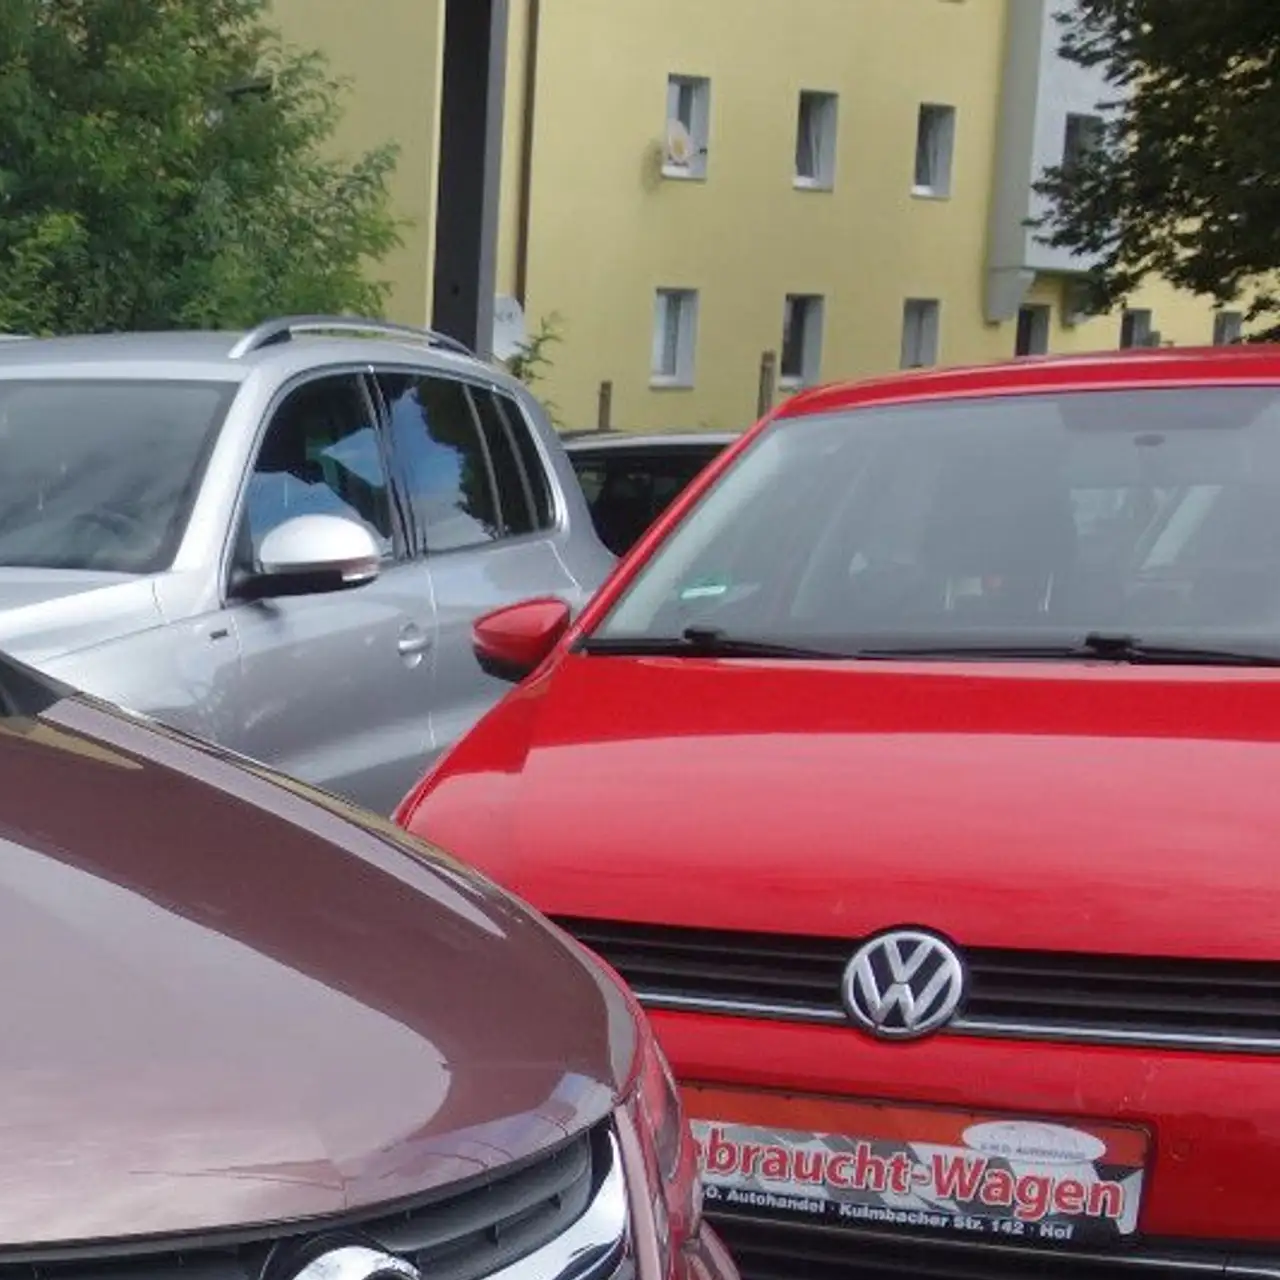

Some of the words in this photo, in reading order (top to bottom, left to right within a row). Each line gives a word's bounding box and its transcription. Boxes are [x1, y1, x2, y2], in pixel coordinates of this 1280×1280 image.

[845, 932, 961, 1032] VW
[692, 1128, 1125, 1221] braucht-Wagen
[726, 1188, 826, 1213] Autohandel
[839, 1201, 951, 1228] Kulmbacher
[953, 1213, 985, 1232] Str.
[991, 1217, 1025, 1236] 142
[1039, 1222, 1074, 1241] Hof
